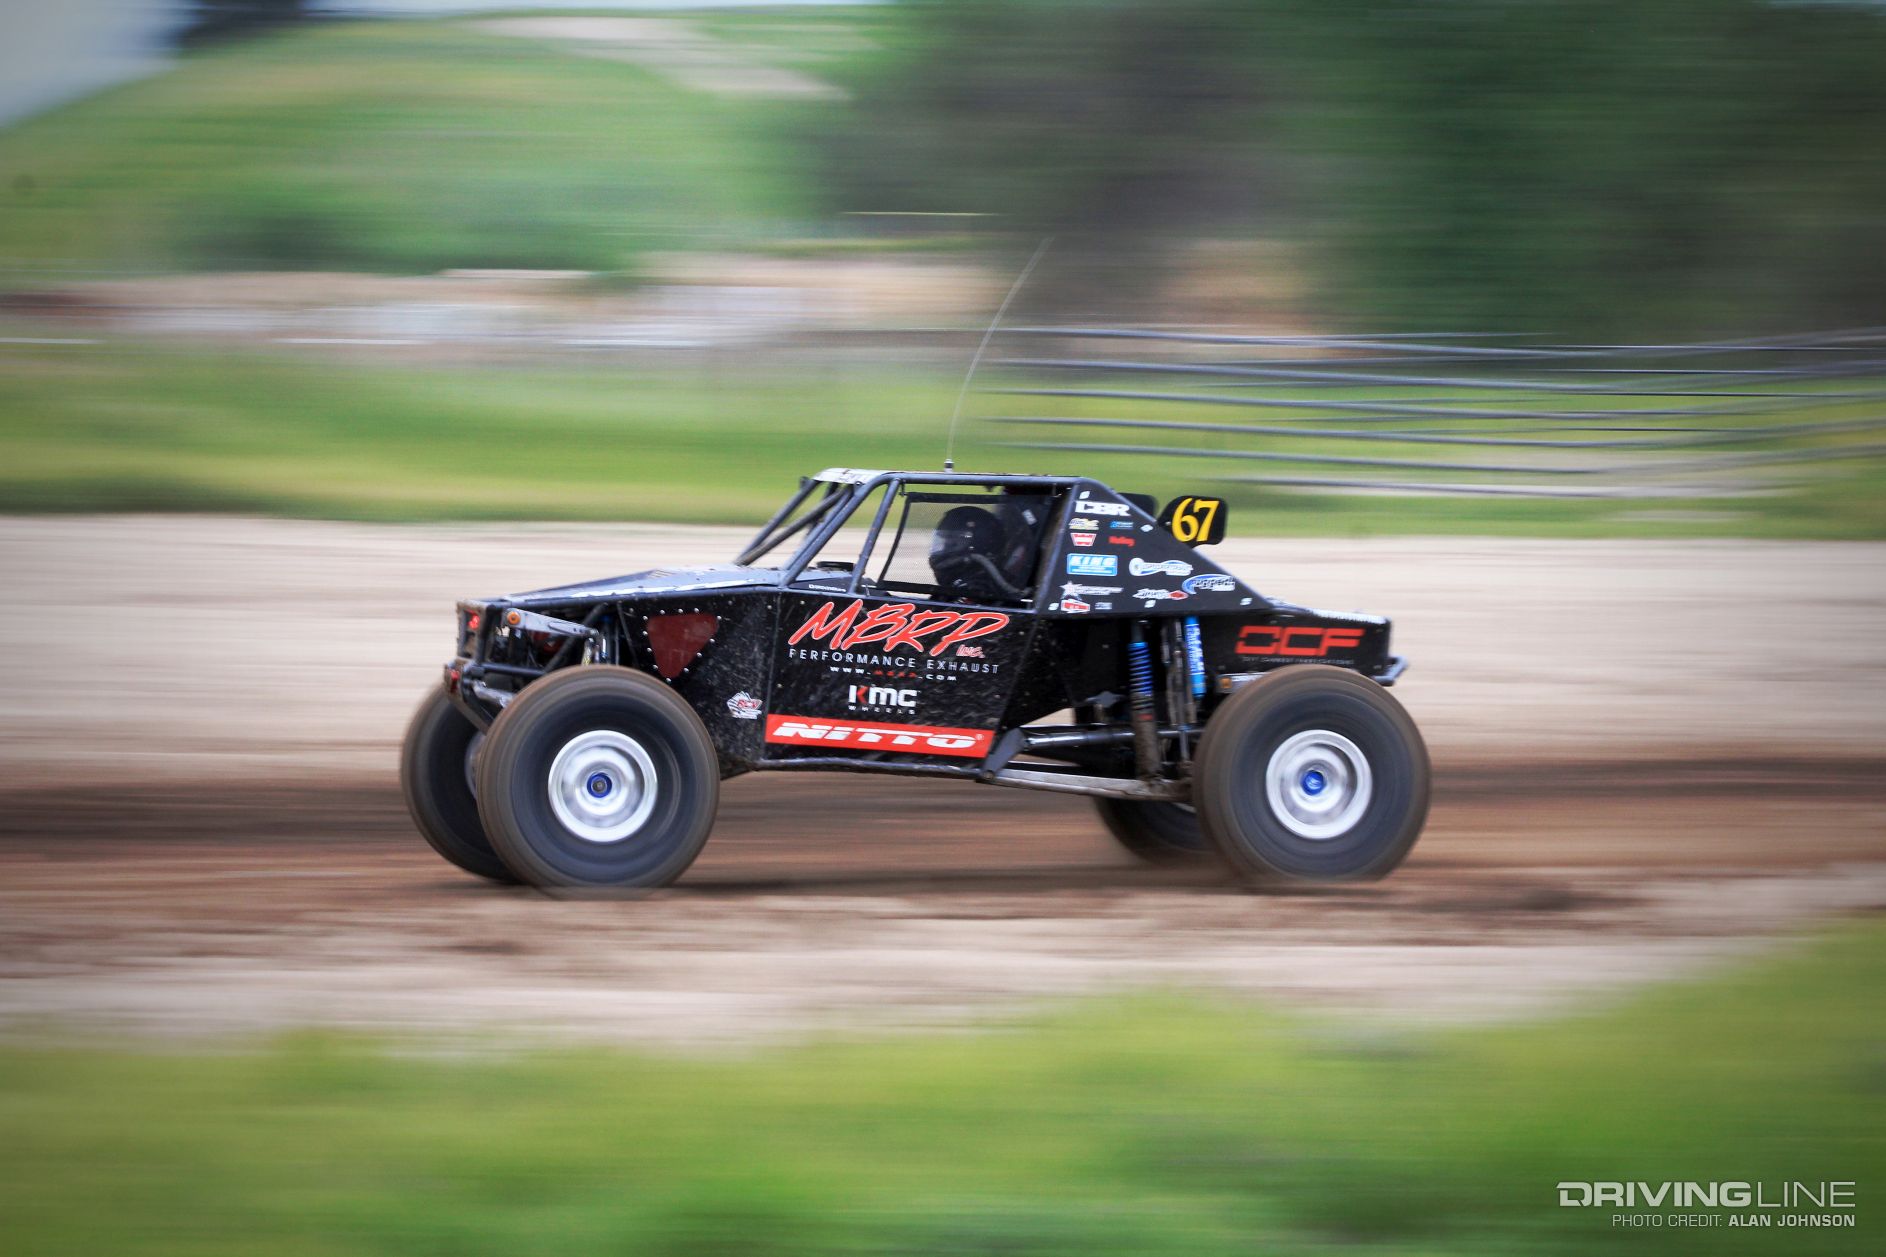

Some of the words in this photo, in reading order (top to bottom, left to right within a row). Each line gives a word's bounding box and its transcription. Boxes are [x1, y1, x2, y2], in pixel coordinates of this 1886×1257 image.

[1172, 498, 1220, 543] 67
[788, 598, 1010, 657] MBRP
[788, 648, 917, 668] PERFORMANCE
[926, 659, 1000, 674] EXHAUST
[772, 722, 976, 749] NITTO
